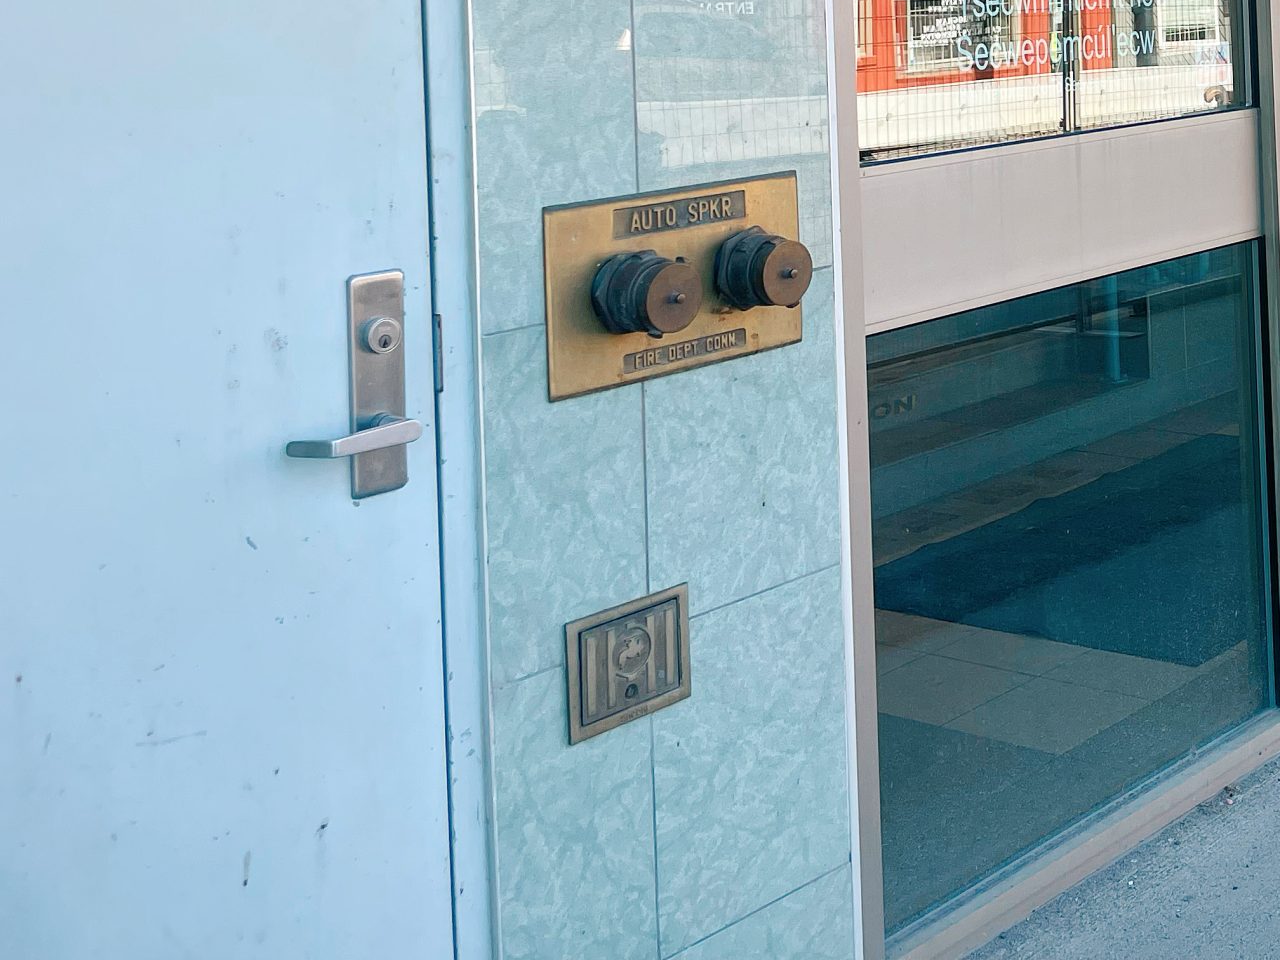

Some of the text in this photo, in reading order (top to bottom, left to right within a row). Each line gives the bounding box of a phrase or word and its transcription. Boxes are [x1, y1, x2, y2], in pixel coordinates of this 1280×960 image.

[630, 206, 677, 233] AUTO
[634, 350, 661, 370] FIRE
[706, 333, 737, 354] CONN
